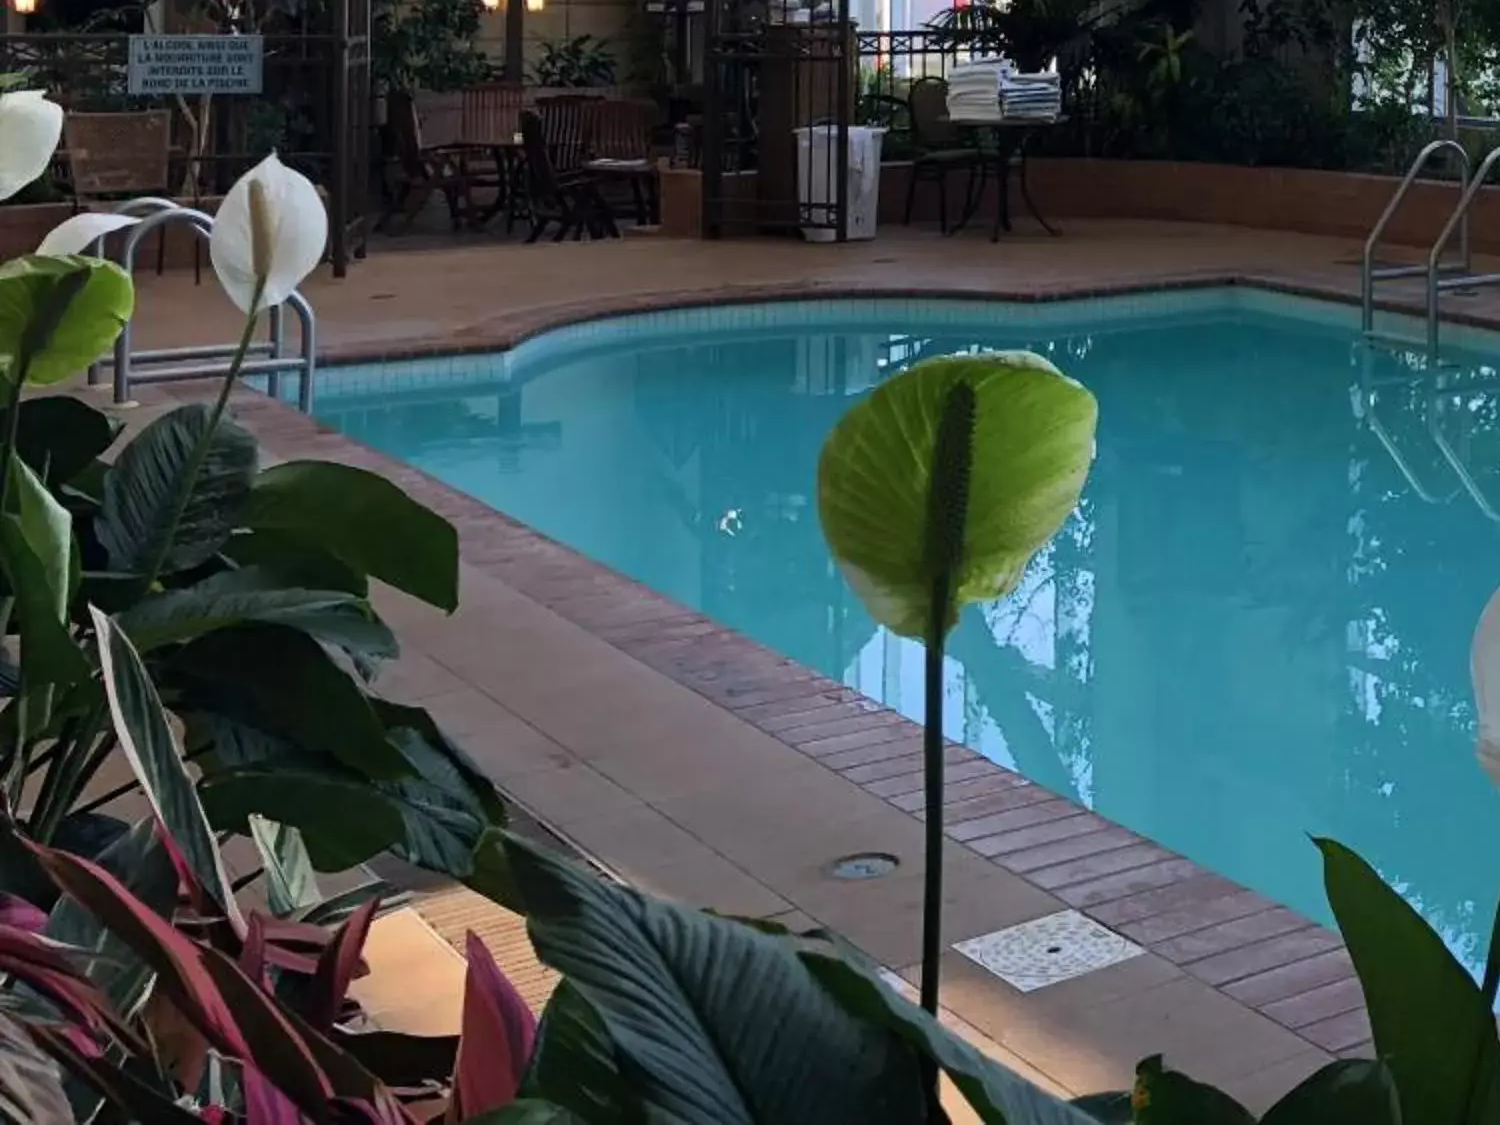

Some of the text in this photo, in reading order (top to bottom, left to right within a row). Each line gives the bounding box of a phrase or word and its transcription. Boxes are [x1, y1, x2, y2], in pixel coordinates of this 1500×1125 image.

[229, 40, 249, 51] QUE
[137, 53, 150, 64] LA
[226, 53, 254, 64] SONT
[207, 65, 228, 76] SUR
[231, 65, 245, 76] LE
[175, 78, 188, 89] DE
[192, 78, 206, 89] LA
